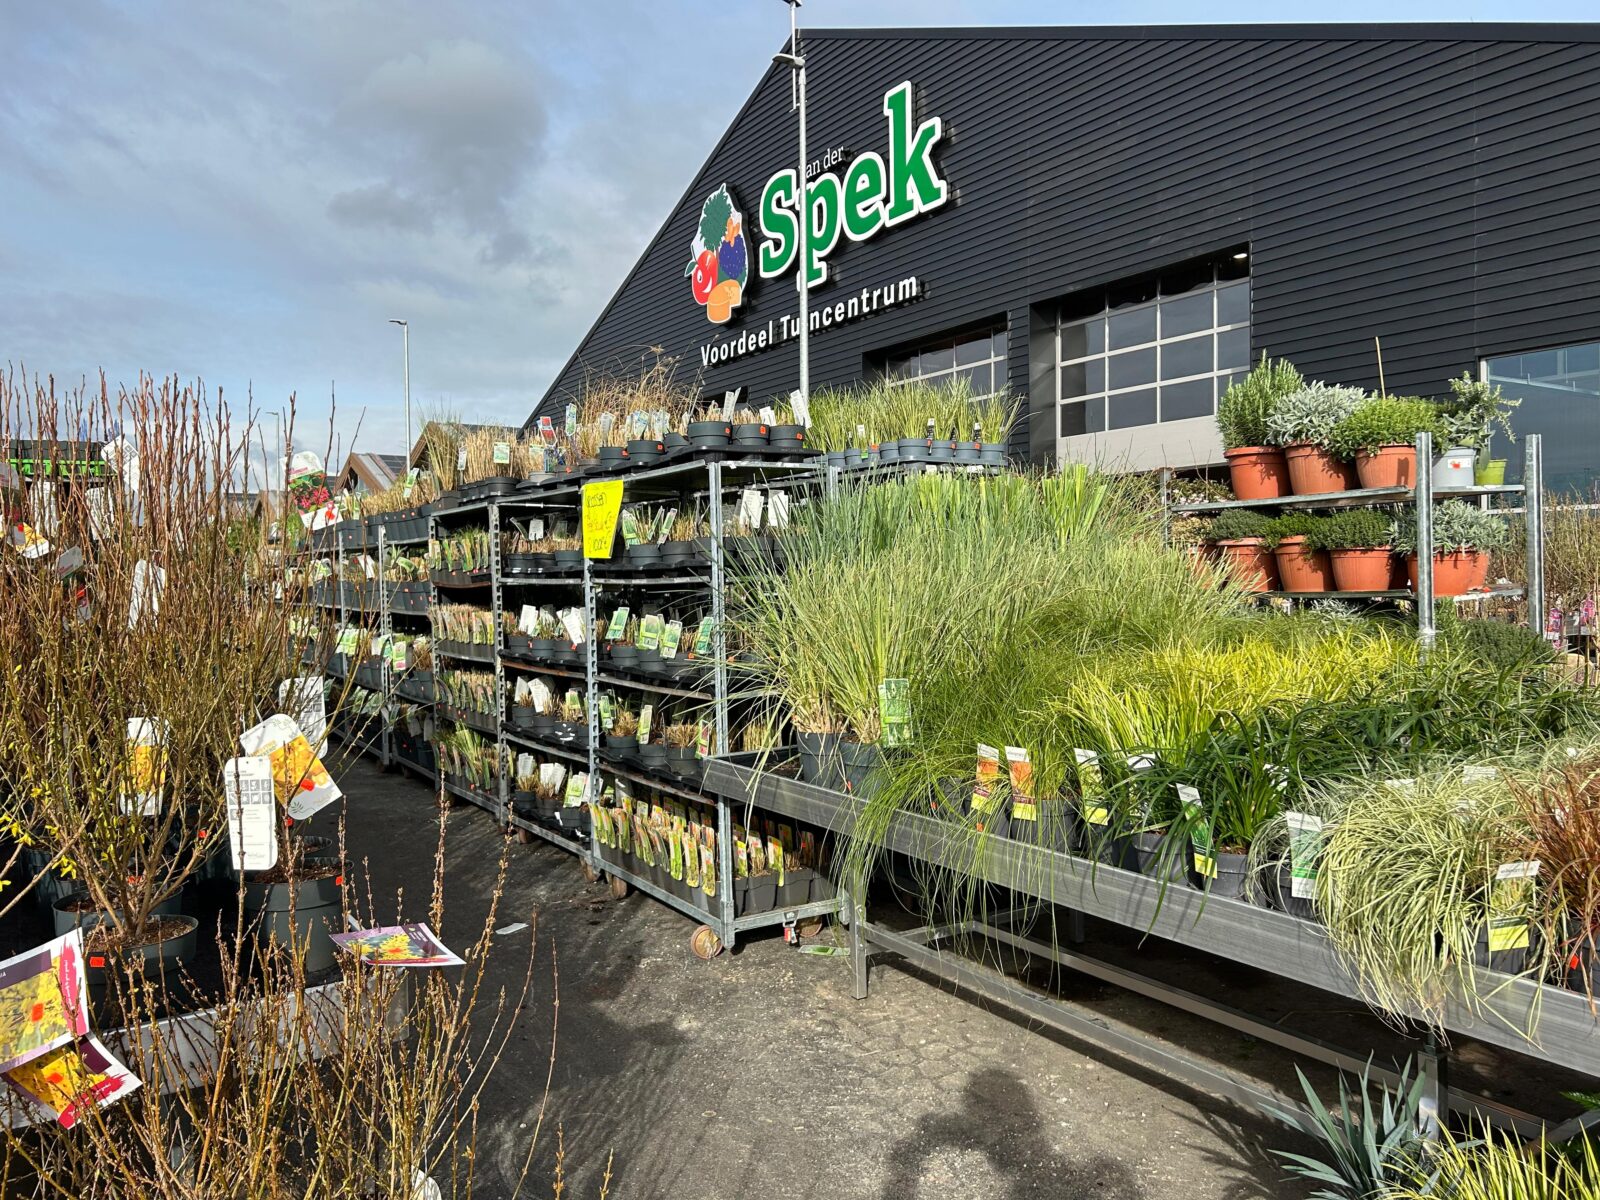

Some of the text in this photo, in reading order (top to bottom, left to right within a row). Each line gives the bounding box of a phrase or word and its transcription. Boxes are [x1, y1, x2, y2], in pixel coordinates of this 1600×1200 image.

[760, 80, 947, 291] Spek
[798, 146, 844, 178] an der
[701, 276, 917, 366] Voordeel Tuncentrum
